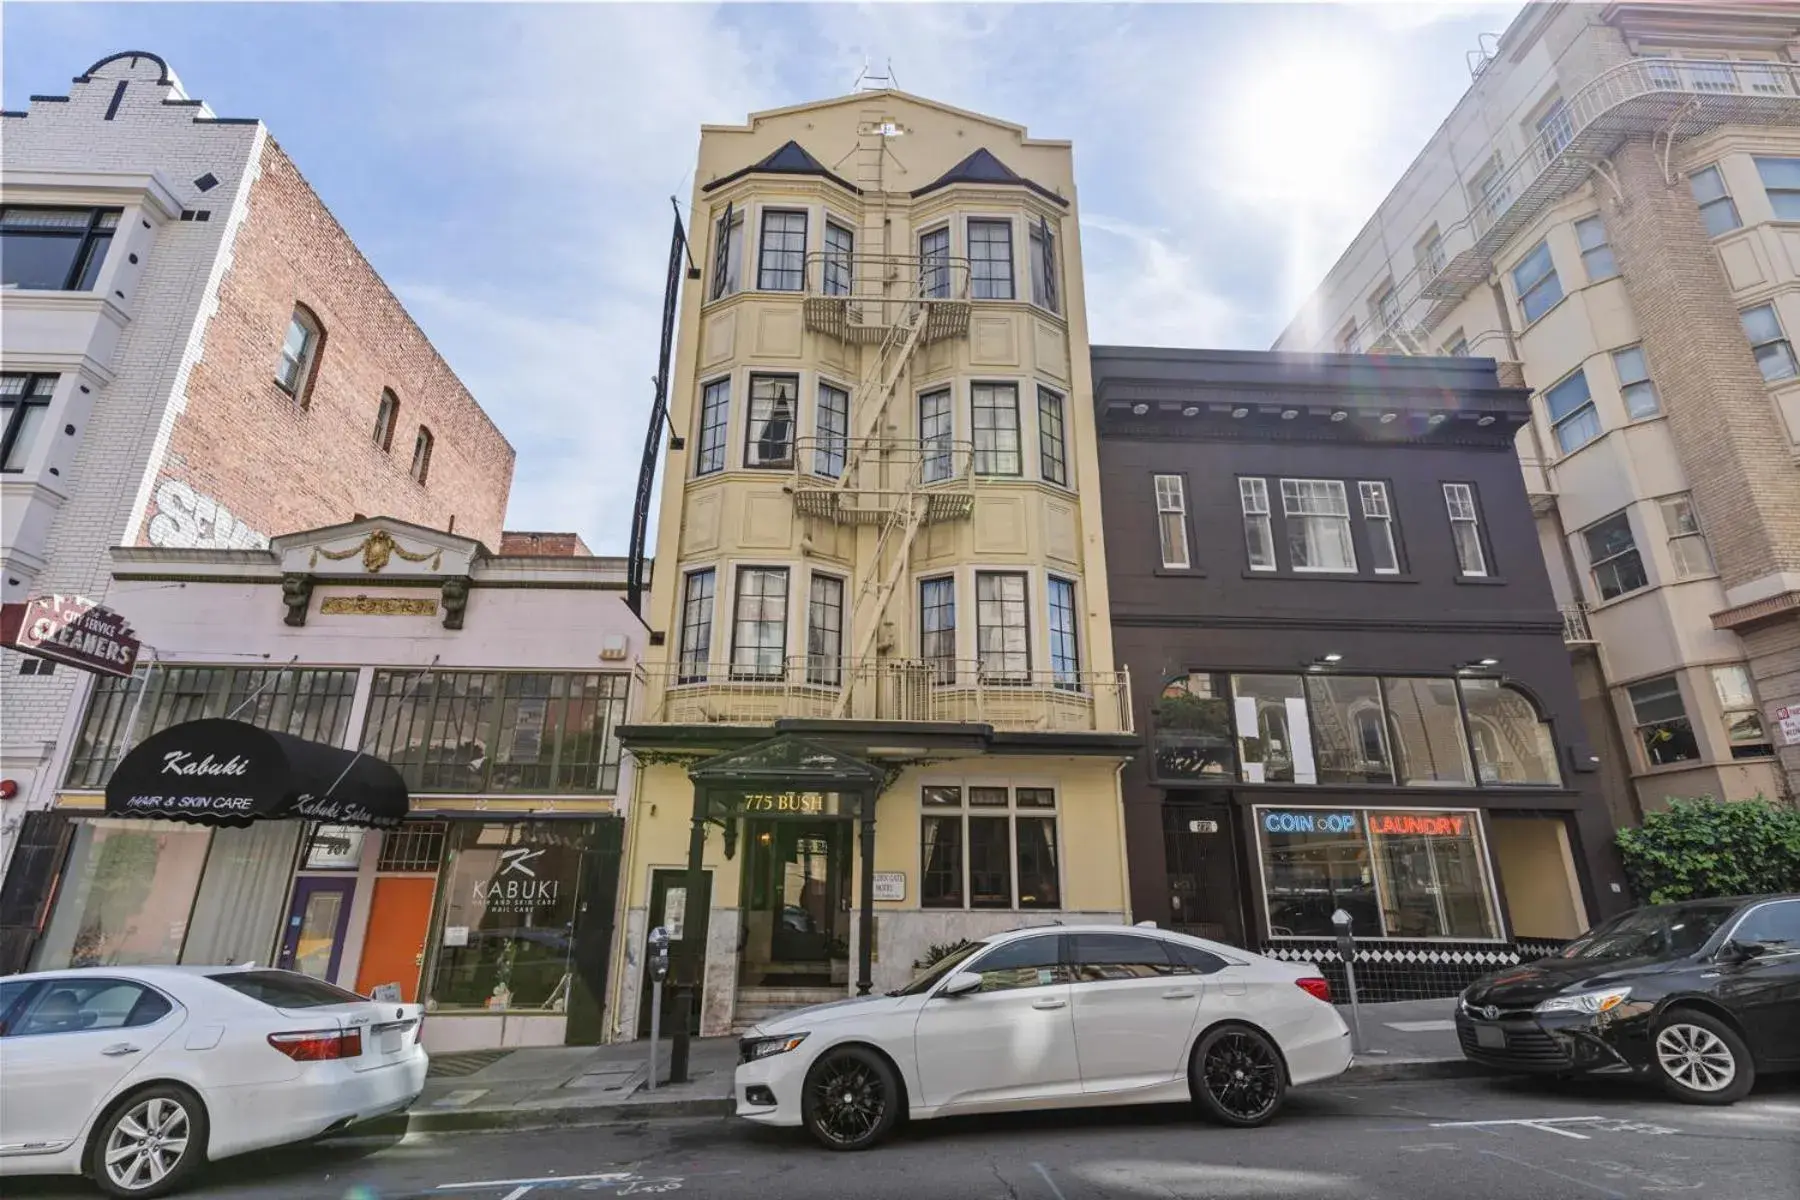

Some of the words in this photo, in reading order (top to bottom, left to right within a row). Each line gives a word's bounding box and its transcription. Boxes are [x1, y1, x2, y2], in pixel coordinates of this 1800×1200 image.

[85, 617, 116, 637] SERVICE
[32, 618, 131, 665] CLEANERS
[161, 751, 249, 775] Kabuki
[127, 796, 163, 807] HAIR
[164, 797, 176, 807] &
[178, 797, 212, 808] SKIN
[212, 797, 254, 810] CARE
[289, 793, 341, 818] Kabuki
[745, 794, 773, 810] 775
[778, 795, 823, 811] BUSH
[1265, 814, 1314, 832] COIN
[1369, 816, 1462, 835] LAUNDRY
[472, 880, 559, 899] KABUKI
